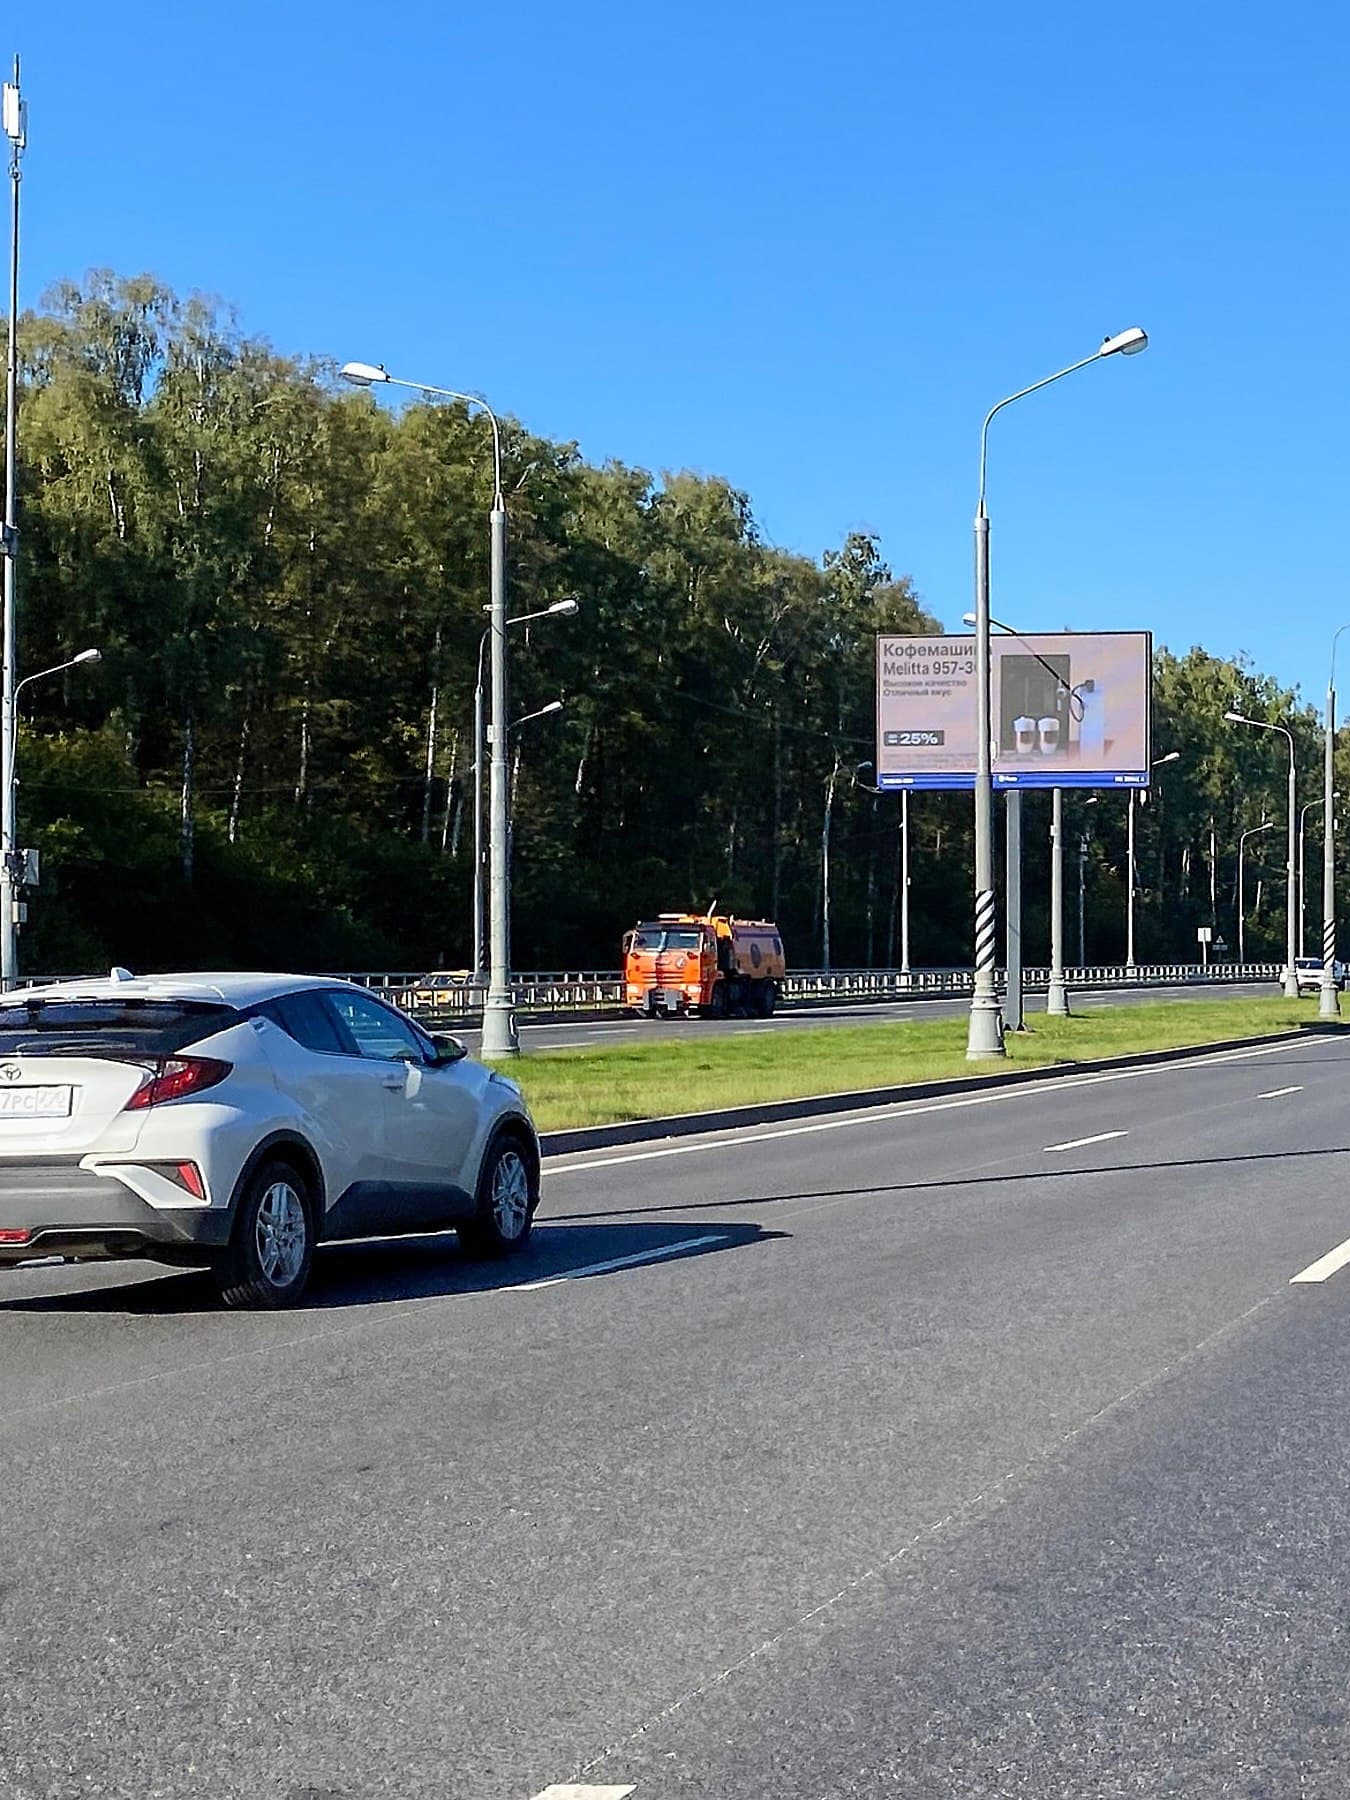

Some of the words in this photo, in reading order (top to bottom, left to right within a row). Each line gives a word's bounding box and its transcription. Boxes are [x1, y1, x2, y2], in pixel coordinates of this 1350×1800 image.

[884, 643, 993, 659] Кофемаши
[884, 662, 930, 675] Melitta
[932, 661, 977, 675] 957-3
